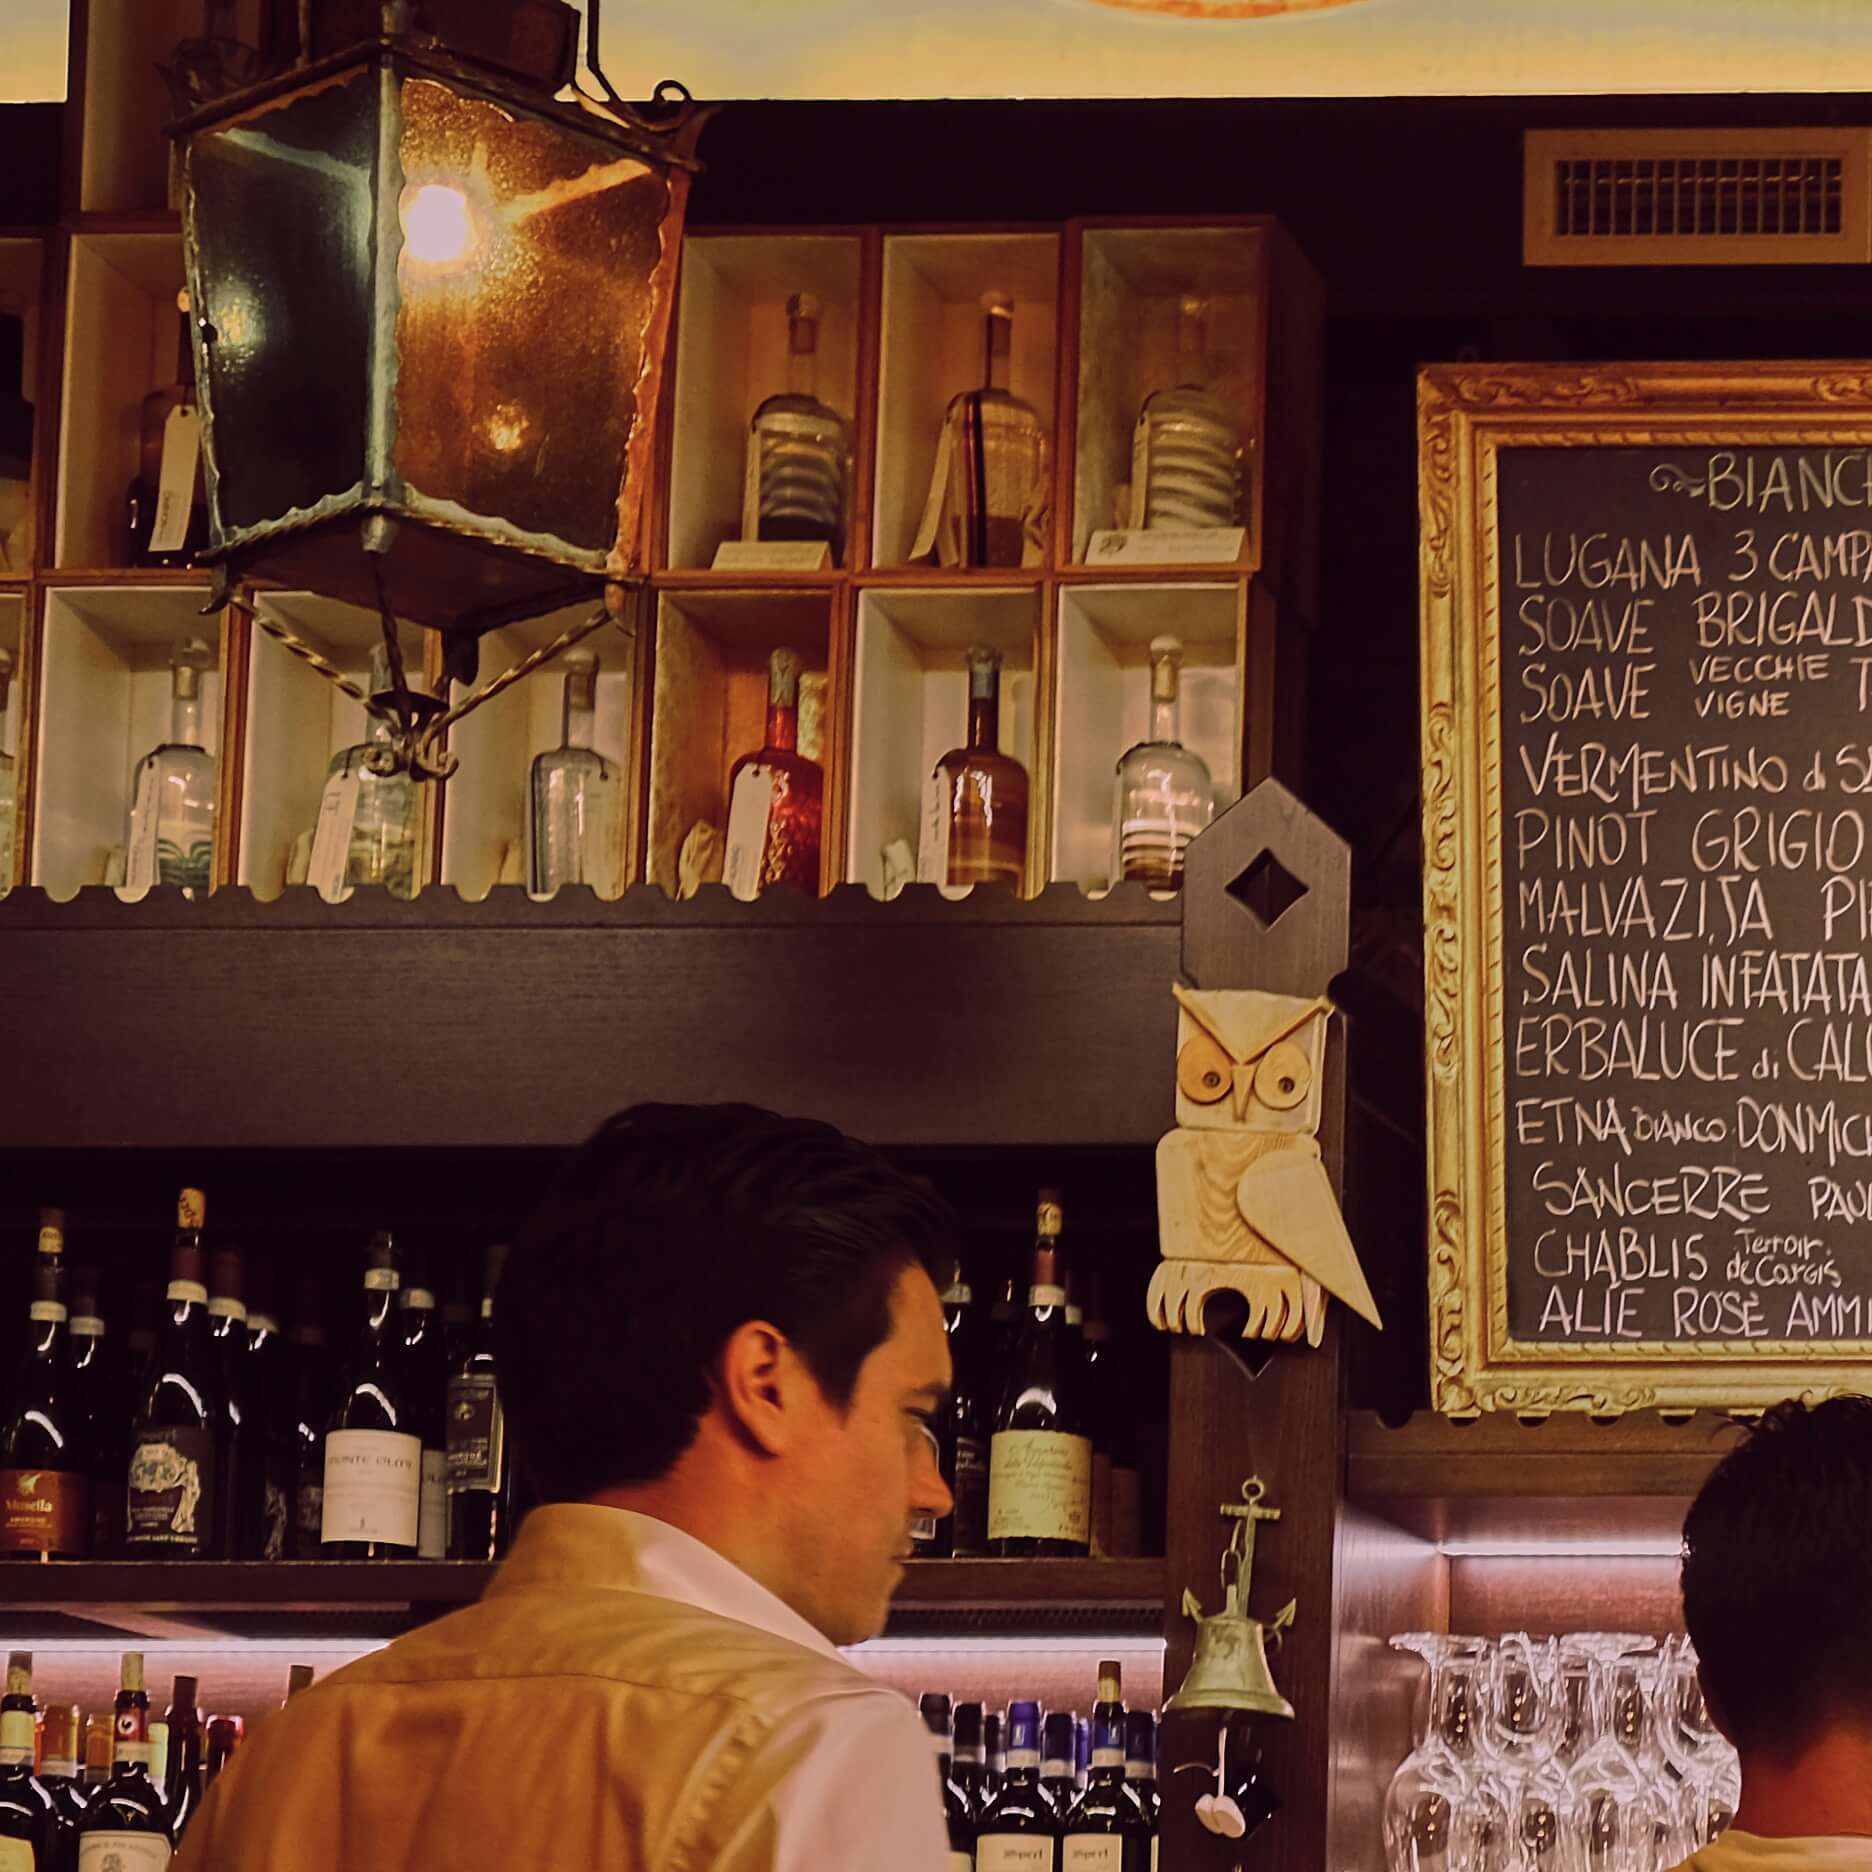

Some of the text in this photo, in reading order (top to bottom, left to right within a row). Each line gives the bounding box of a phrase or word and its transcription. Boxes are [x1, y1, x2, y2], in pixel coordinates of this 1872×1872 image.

[1514, 532, 1700, 591] LUGANA
[1728, 531, 1758, 581] 3
[1519, 595, 1654, 656] SOAVE
[1519, 661, 1655, 724] SOAVE
[1689, 654, 1829, 684] VECCHIE
[1695, 689, 1791, 718] VIGNE
[1519, 731, 1789, 811] VERMENTINO
[1515, 809, 1658, 872] PINOT
[1691, 809, 1864, 872] GRIGIO
[1521, 944, 1679, 1012] SALINA
[1701, 950, 1872, 1016] INFATATA
[1515, 1016, 1742, 1081] ERBALUCE
[1751, 1051, 1780, 1082] di
[1518, 1099, 1632, 1155] ETNA
[1532, 1161, 1772, 1220] SANCERRE
[1535, 1230, 1706, 1285] CHABLIS
